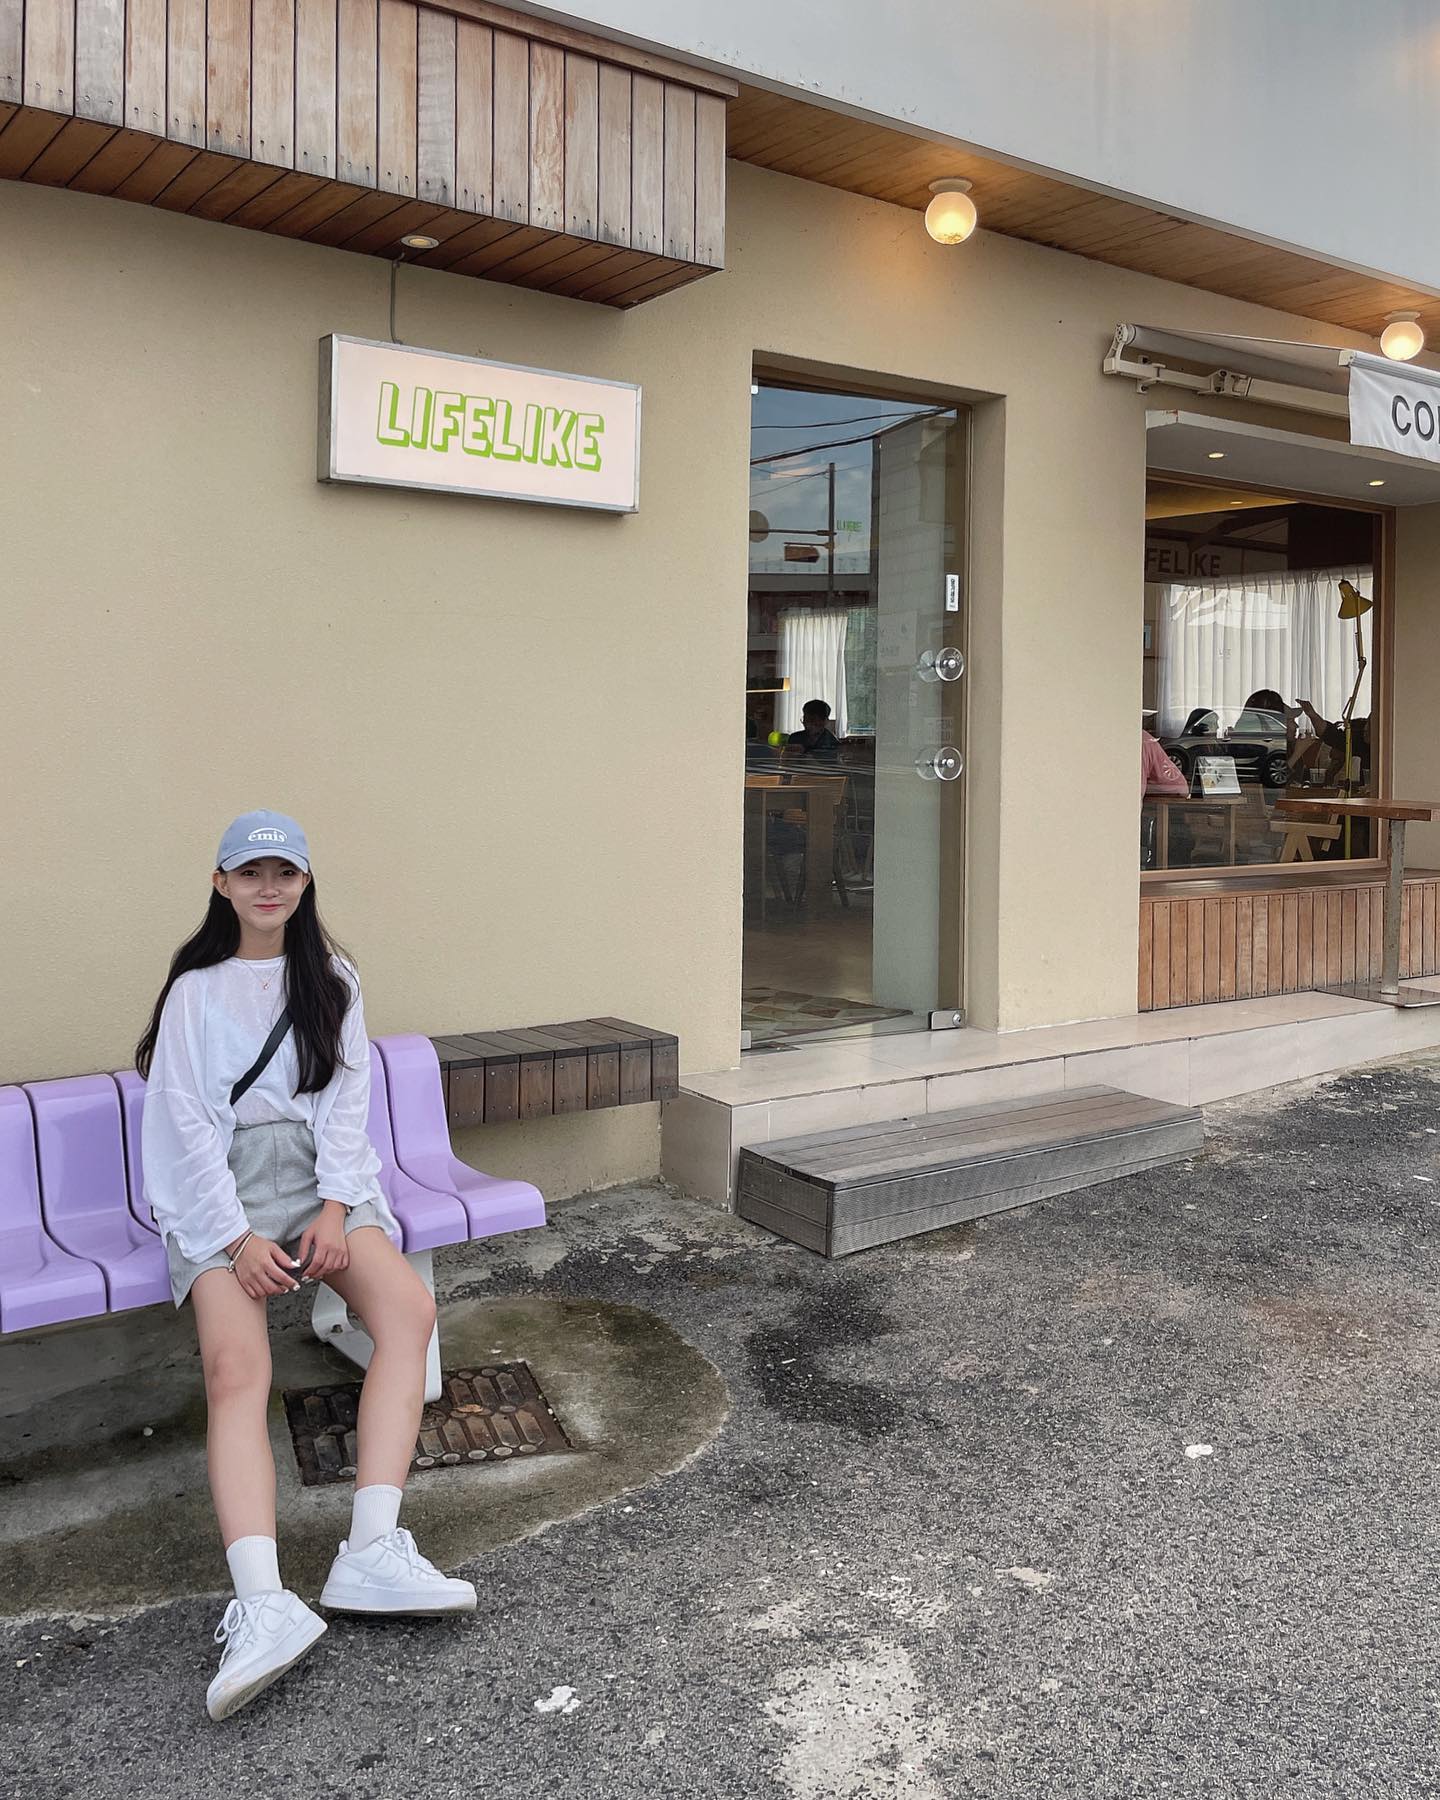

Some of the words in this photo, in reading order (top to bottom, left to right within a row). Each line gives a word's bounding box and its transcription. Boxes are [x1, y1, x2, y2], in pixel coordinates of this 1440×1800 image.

[377, 382, 604, 472] LIFELIKE
[1391, 395, 1440, 444] CO
[248, 830, 286, 843] emis
